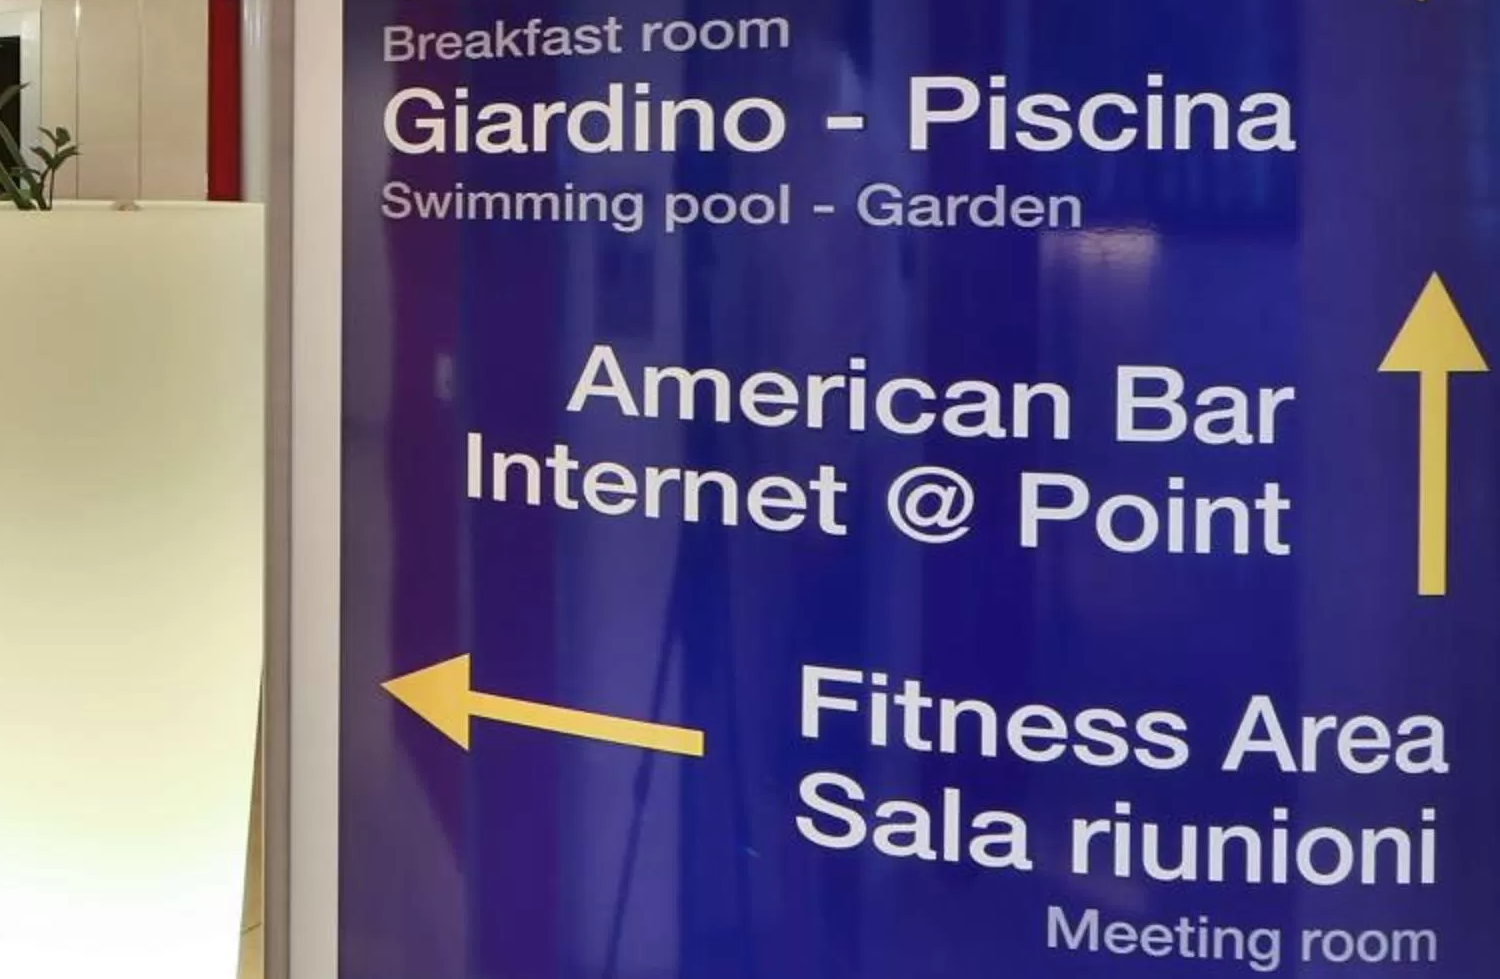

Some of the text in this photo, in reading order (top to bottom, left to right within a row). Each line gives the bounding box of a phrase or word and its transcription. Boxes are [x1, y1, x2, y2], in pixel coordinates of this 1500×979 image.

[382, 16, 790, 62] Breakfast room
[382, 74, 1297, 155] Giardino - Piscina
[382, 182, 1082, 233] Swimming pool - Garden
[565, 345, 1296, 446] American Bar
[466, 432, 1292, 557] Internet @ Point
[800, 664, 1450, 775] Fitness Area
[794, 771, 1436, 887] Sala riunioni
[1047, 905, 1436, 973] Meeting room
